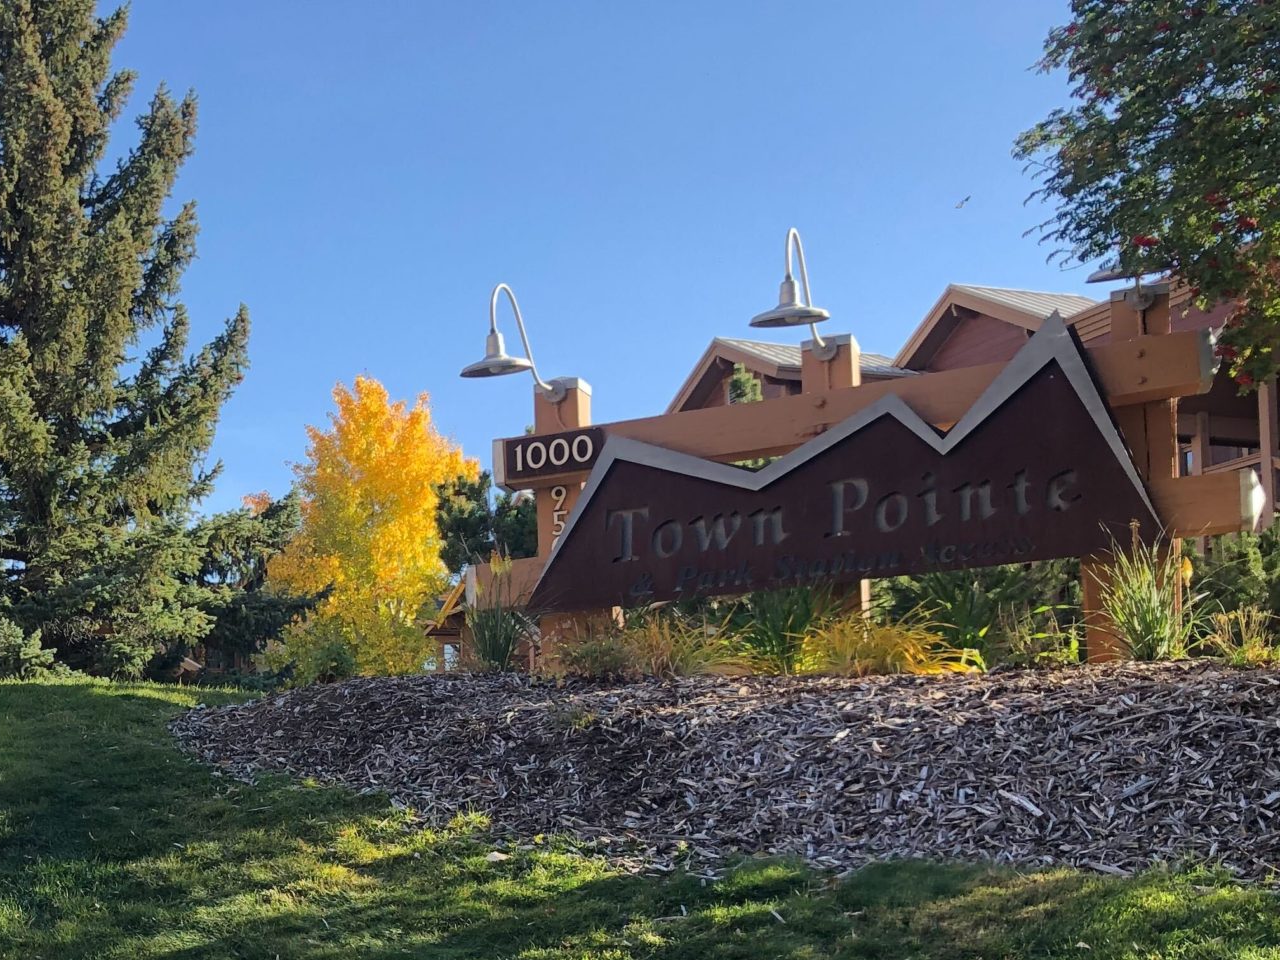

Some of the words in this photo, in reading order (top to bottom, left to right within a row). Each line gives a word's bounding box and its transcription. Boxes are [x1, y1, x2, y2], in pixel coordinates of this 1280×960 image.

[514, 434, 594, 472] 1000
[606, 504, 792, 563] Town
[823, 467, 1083, 539] Pointe
